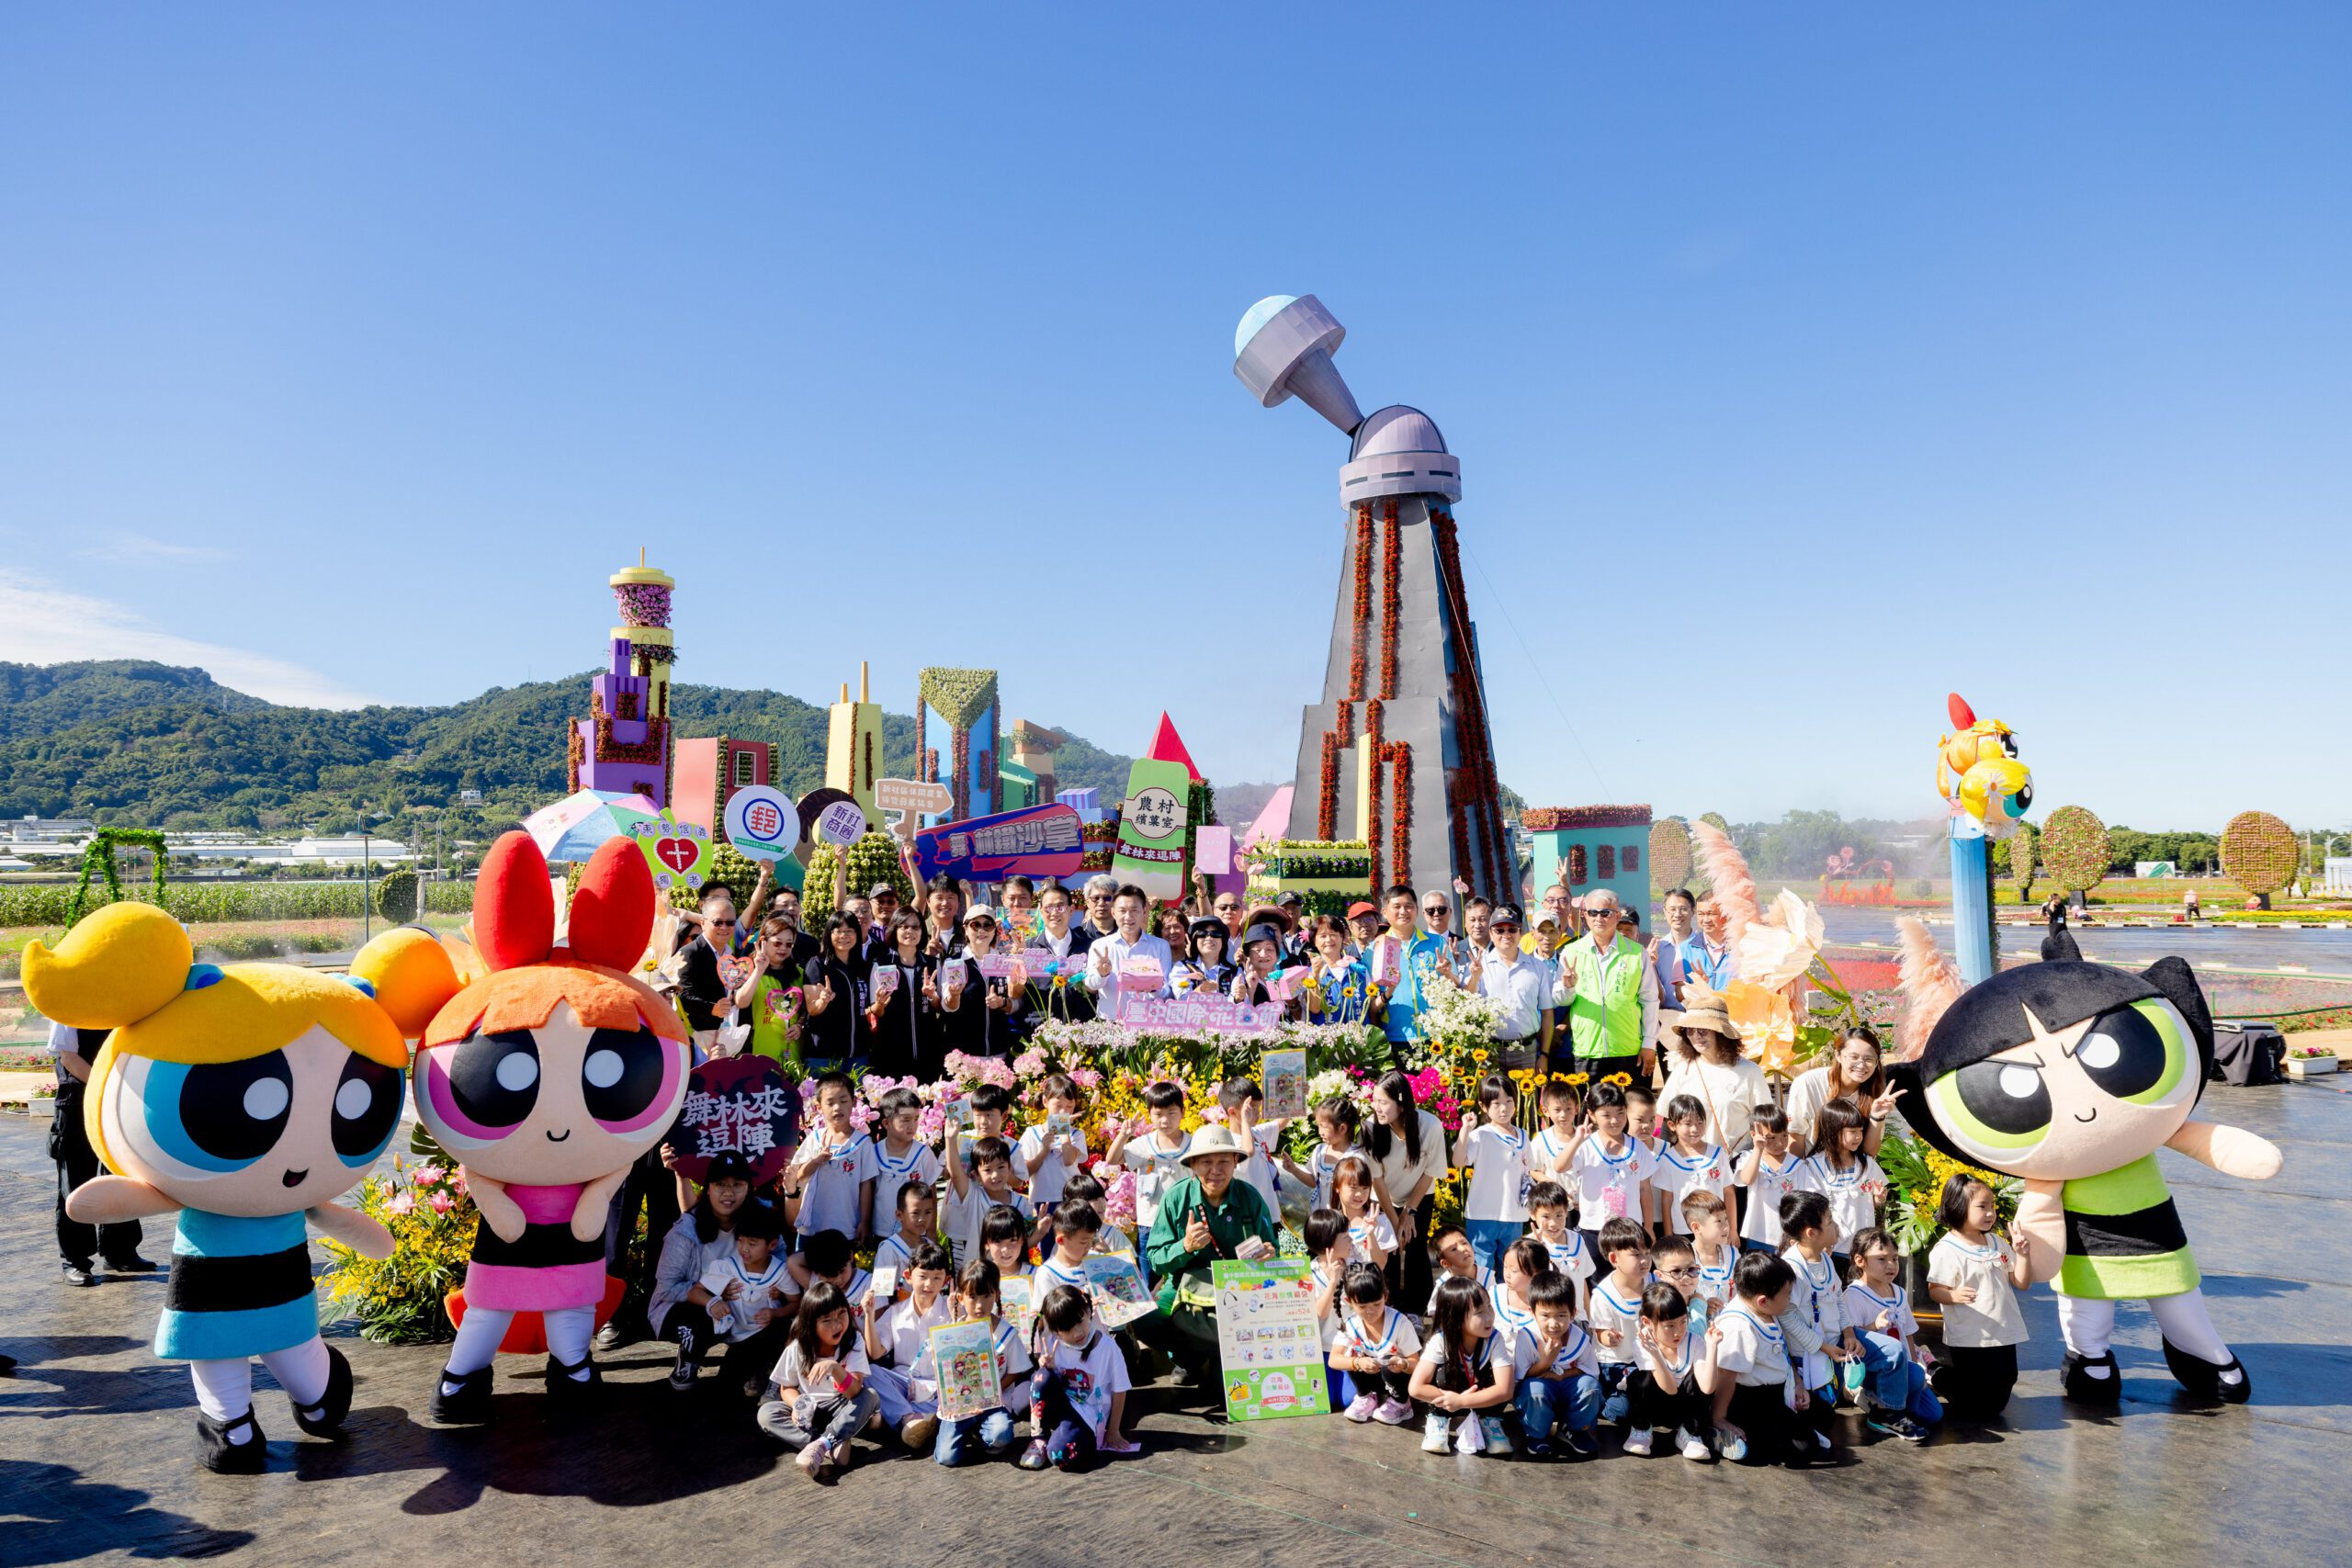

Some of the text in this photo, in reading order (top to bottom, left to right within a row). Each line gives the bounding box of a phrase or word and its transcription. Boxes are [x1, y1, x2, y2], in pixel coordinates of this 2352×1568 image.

[1137, 796, 1175, 814] 農村
[750, 806, 777, 834] 郵
[825, 817, 855, 840] 商圈
[832, 805, 862, 829] 新社
[643, 823, 707, 838] 東勢信義
[1190, 993, 1226, 1003] 2025
[682, 1084, 789, 1129] 舞林來
[695, 1122, 777, 1164] 逗陣
